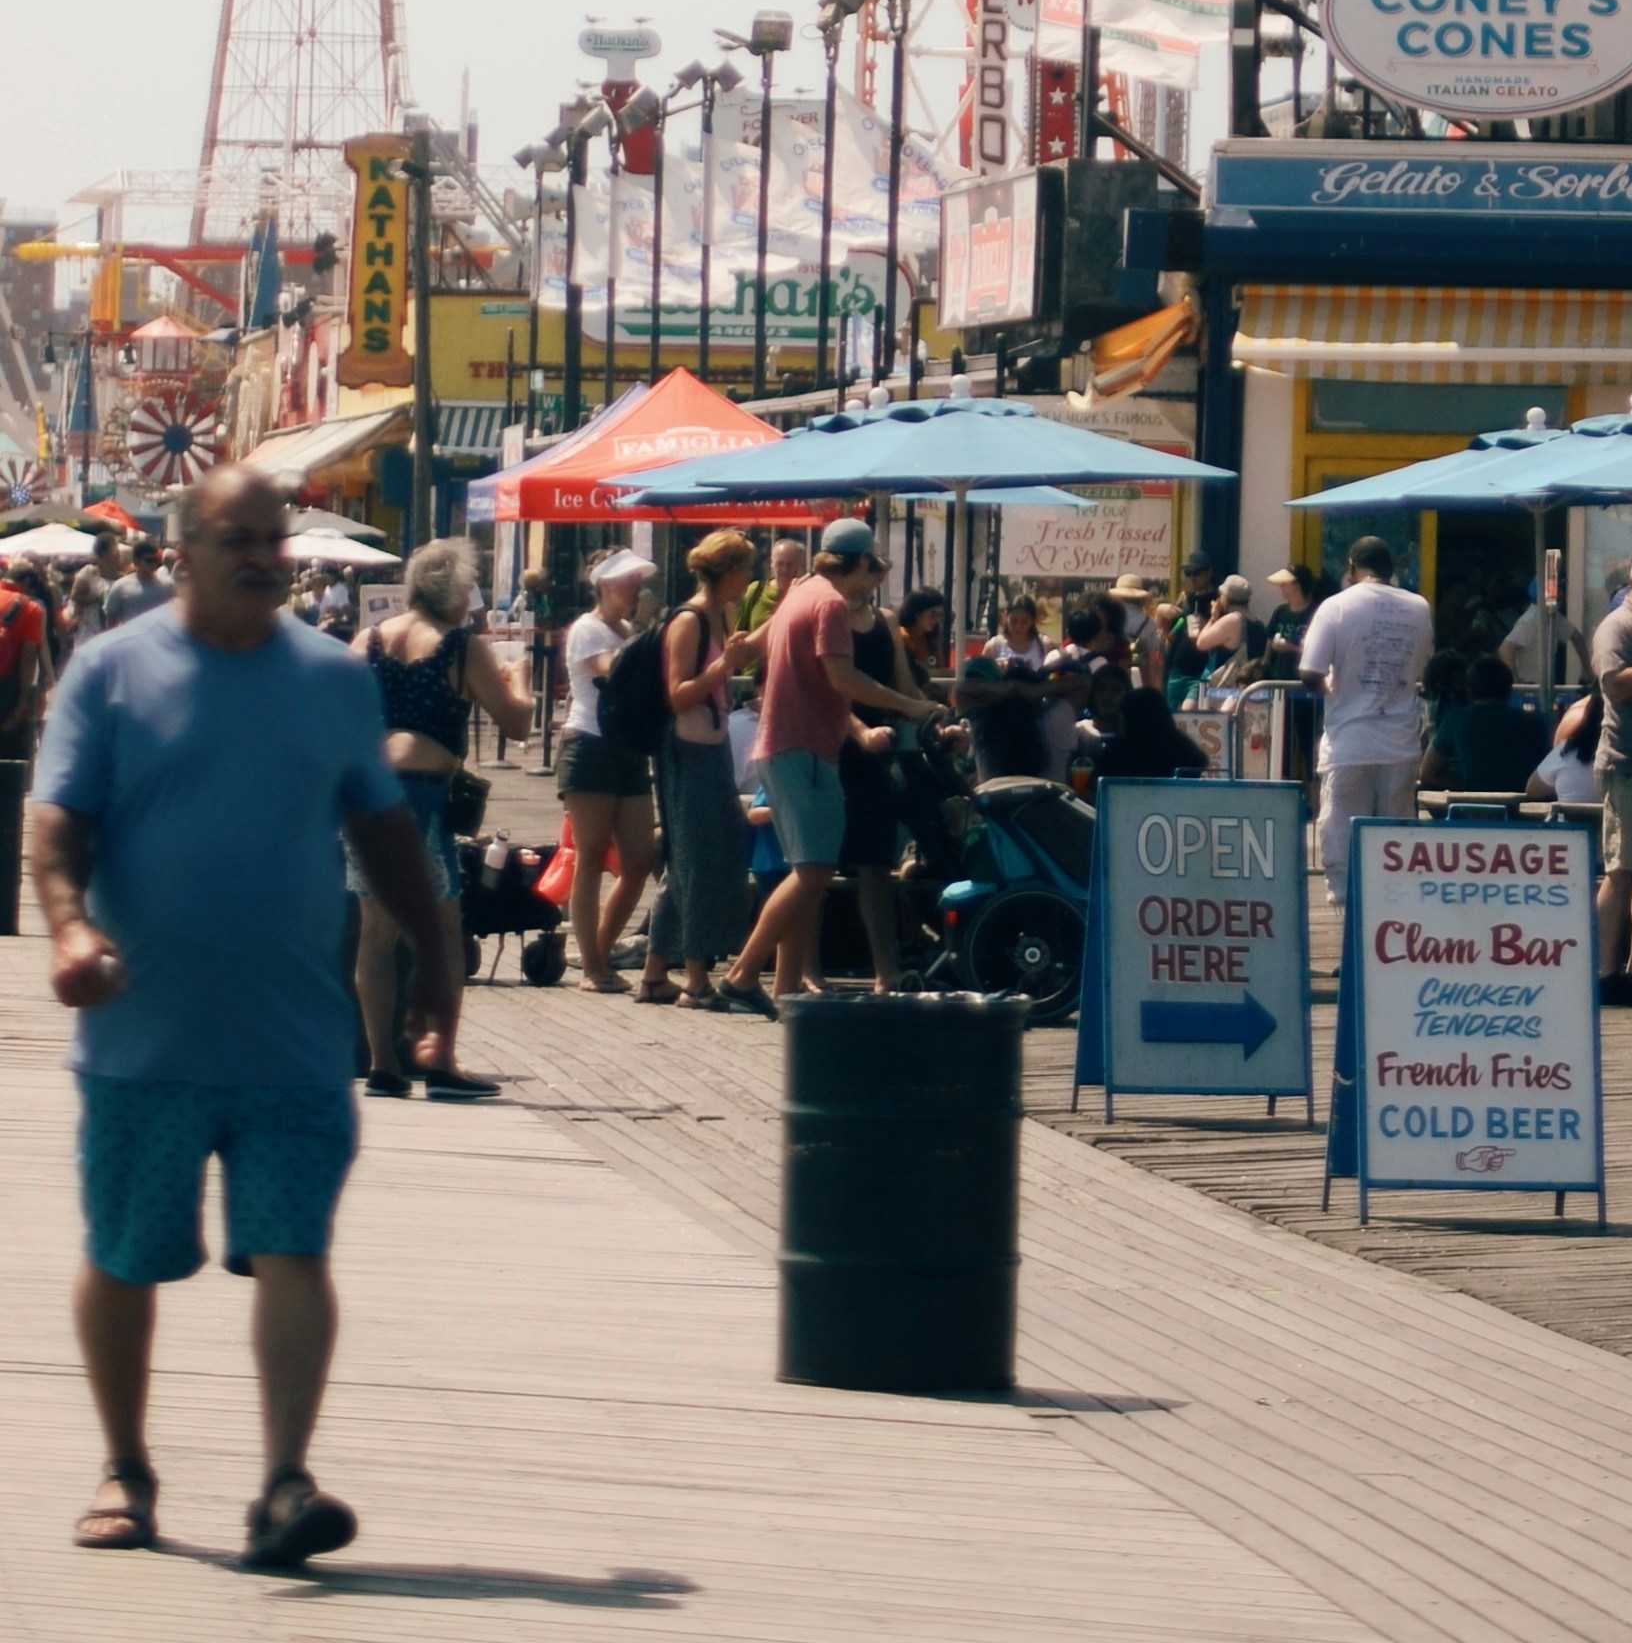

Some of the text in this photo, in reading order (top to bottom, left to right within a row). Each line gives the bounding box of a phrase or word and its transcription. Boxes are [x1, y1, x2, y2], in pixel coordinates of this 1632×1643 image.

[1396, 20, 1593, 59] CONES
[1427, 84, 1558, 97] ITALIAN GELATO
[1455, 76, 1531, 85] HANDMADE
[1311, 160, 1464, 203] Gelato
[621, 434, 757, 458] FAMIGLIA
[553, 487, 583, 508] Ice
[1036, 520, 1168, 545] Fresh Tossed
[1064, 544, 1115, 572] Style
[1137, 813, 1275, 879] OPEN
[1383, 840, 1570, 875] SAUSAGE
[1419, 881, 1570, 906] PEPPERS
[1137, 895, 1275, 939] ORDER
[1375, 920, 1578, 966] Clam Bar
[1151, 944, 1250, 984] HERE
[1417, 977, 1545, 1008] CHICKEN
[1414, 1010, 1543, 1039] TENDERS
[1376, 1051, 1572, 1090] French Fries
[1378, 1104, 1581, 1140] COLD BEER
